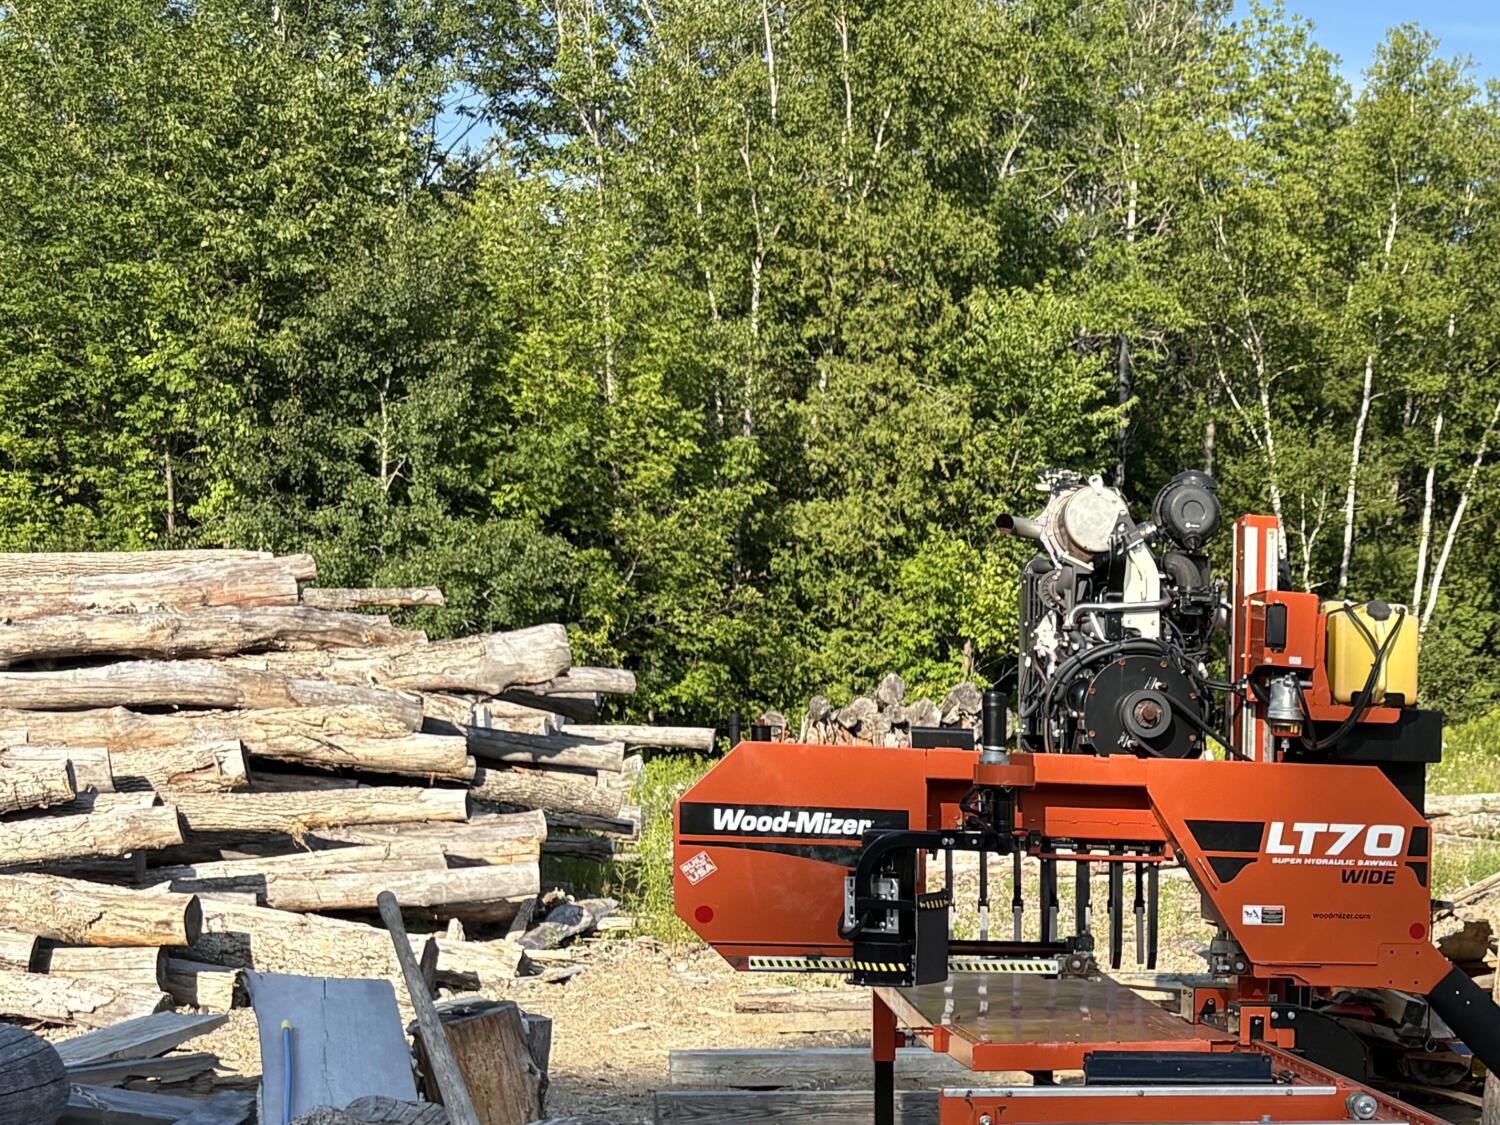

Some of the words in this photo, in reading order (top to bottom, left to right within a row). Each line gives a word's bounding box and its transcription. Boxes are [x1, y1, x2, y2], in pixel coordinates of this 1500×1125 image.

[713, 808, 872, 835] Wood-Mizer
[1265, 821, 1406, 857] LT70
[1272, 857, 1303, 865] SUPER
[1304, 858, 1356, 866] HYDRAULIC
[1357, 859, 1399, 867] SAWMILL
[688, 863, 715, 882] USA
[1341, 869, 1397, 885] WIDE
[1312, 912, 1372, 920] woodmizer.com
